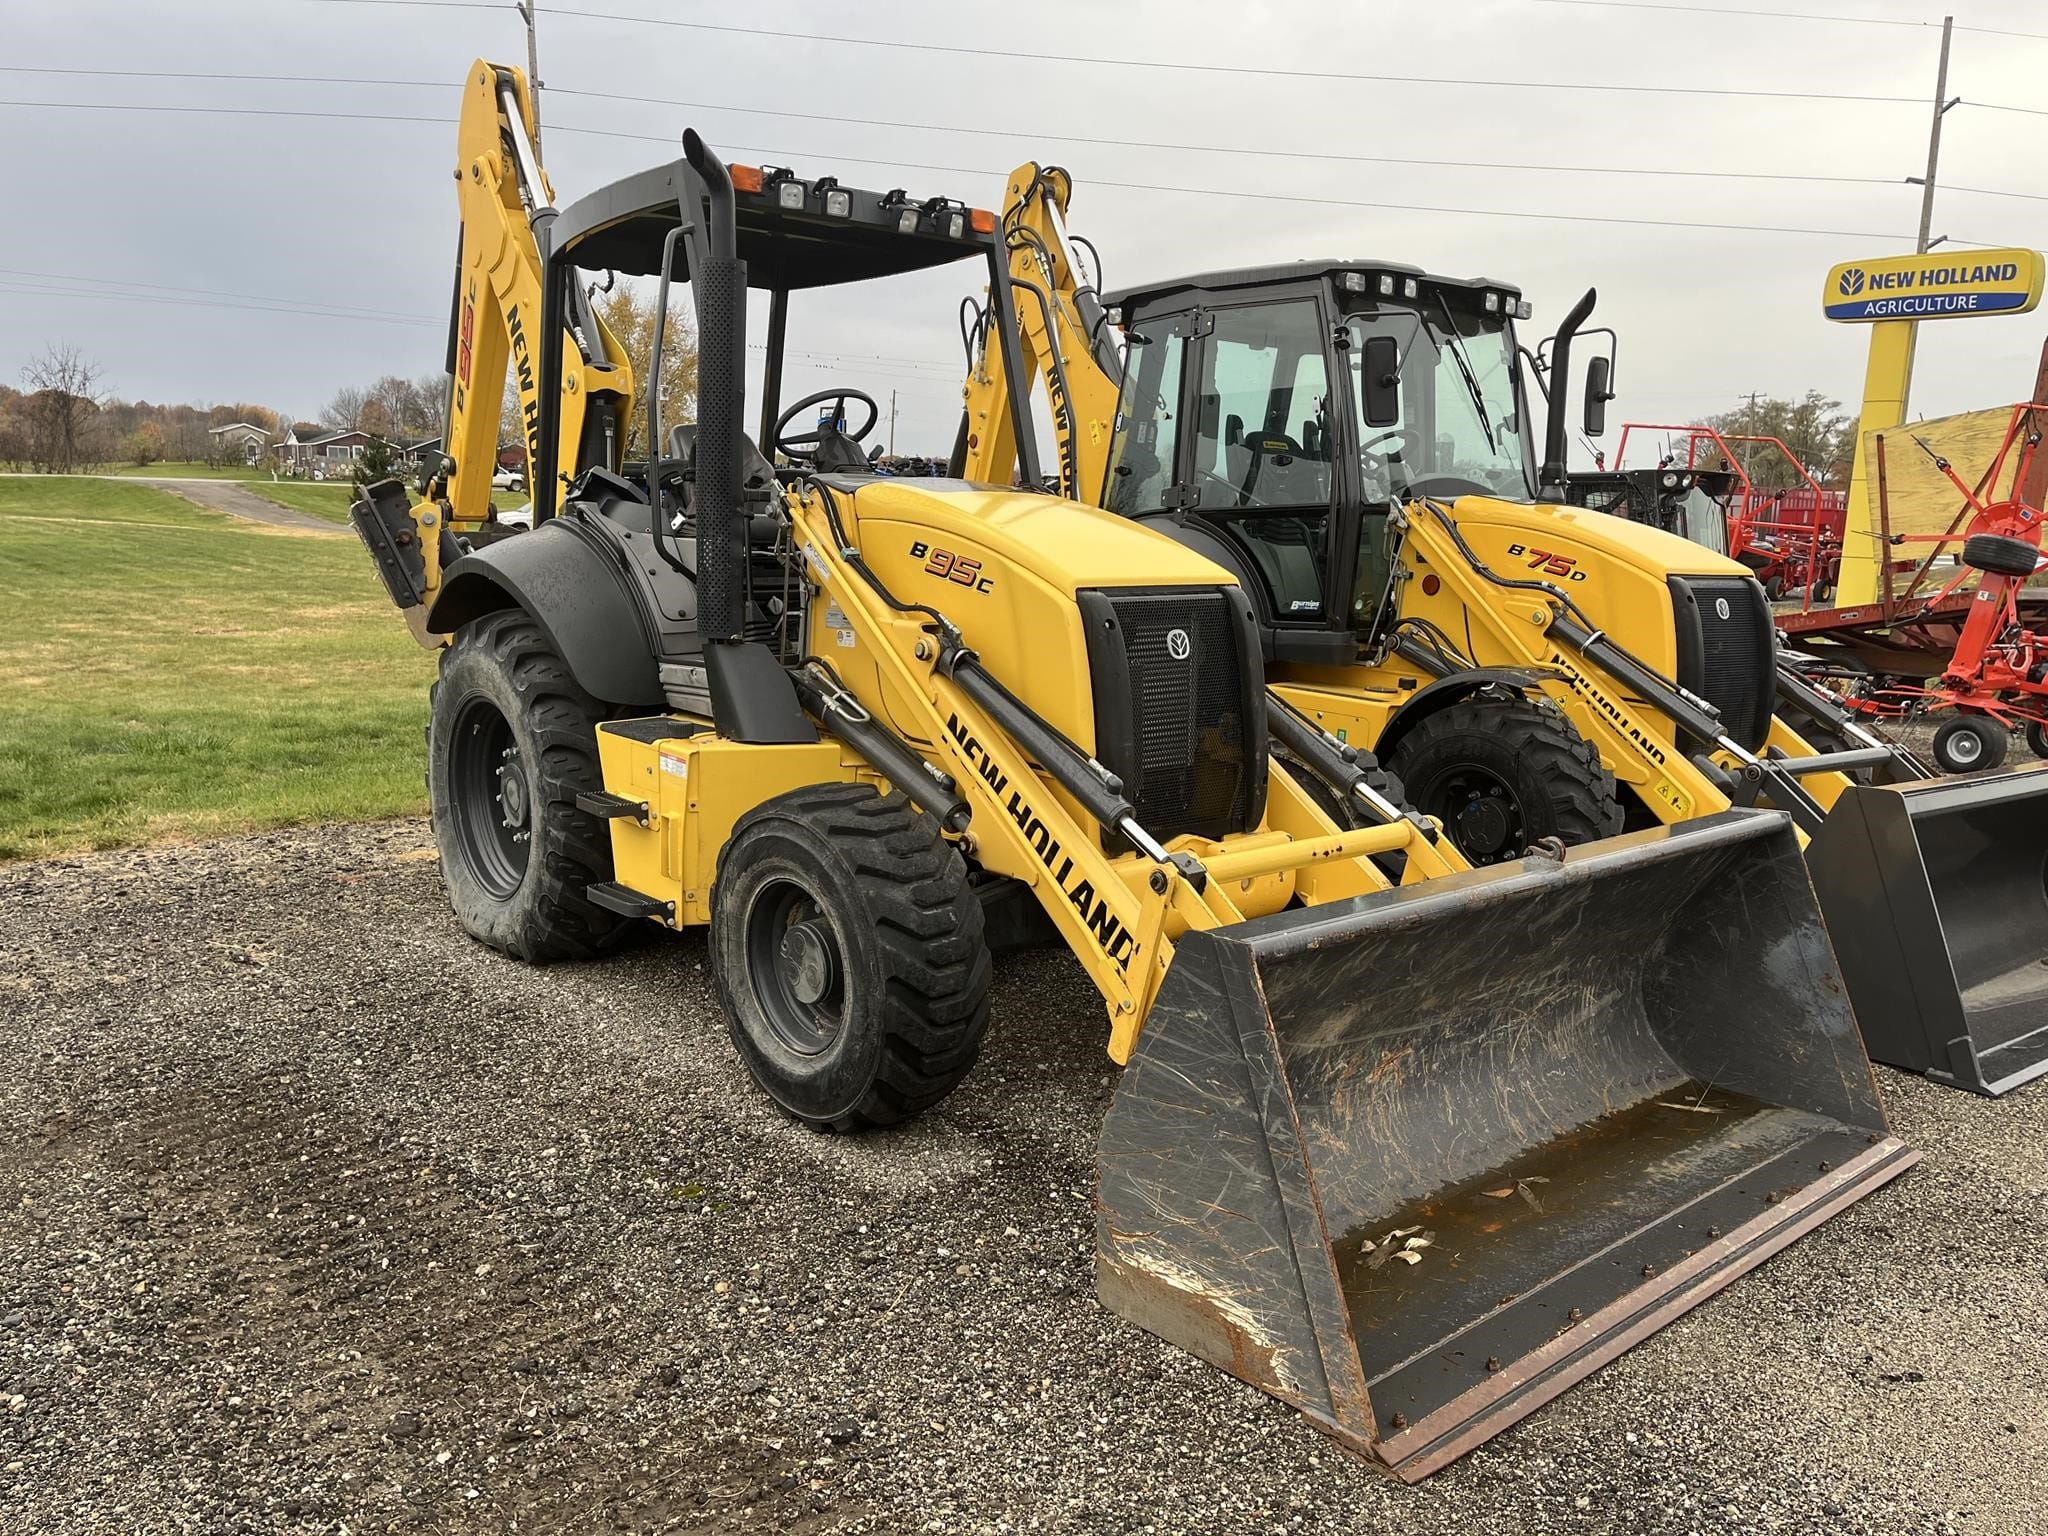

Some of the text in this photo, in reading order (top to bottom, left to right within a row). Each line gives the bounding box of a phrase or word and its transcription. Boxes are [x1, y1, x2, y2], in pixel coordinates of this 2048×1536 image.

[1864, 295, 1978, 315] AGRICULTURE
[1869, 263, 2018, 290] NEW HOLLAND
[507, 303, 534, 392] NEW
[1047, 364, 1068, 431] NEW
[941, 712, 1136, 973] NEW HOLLAND
